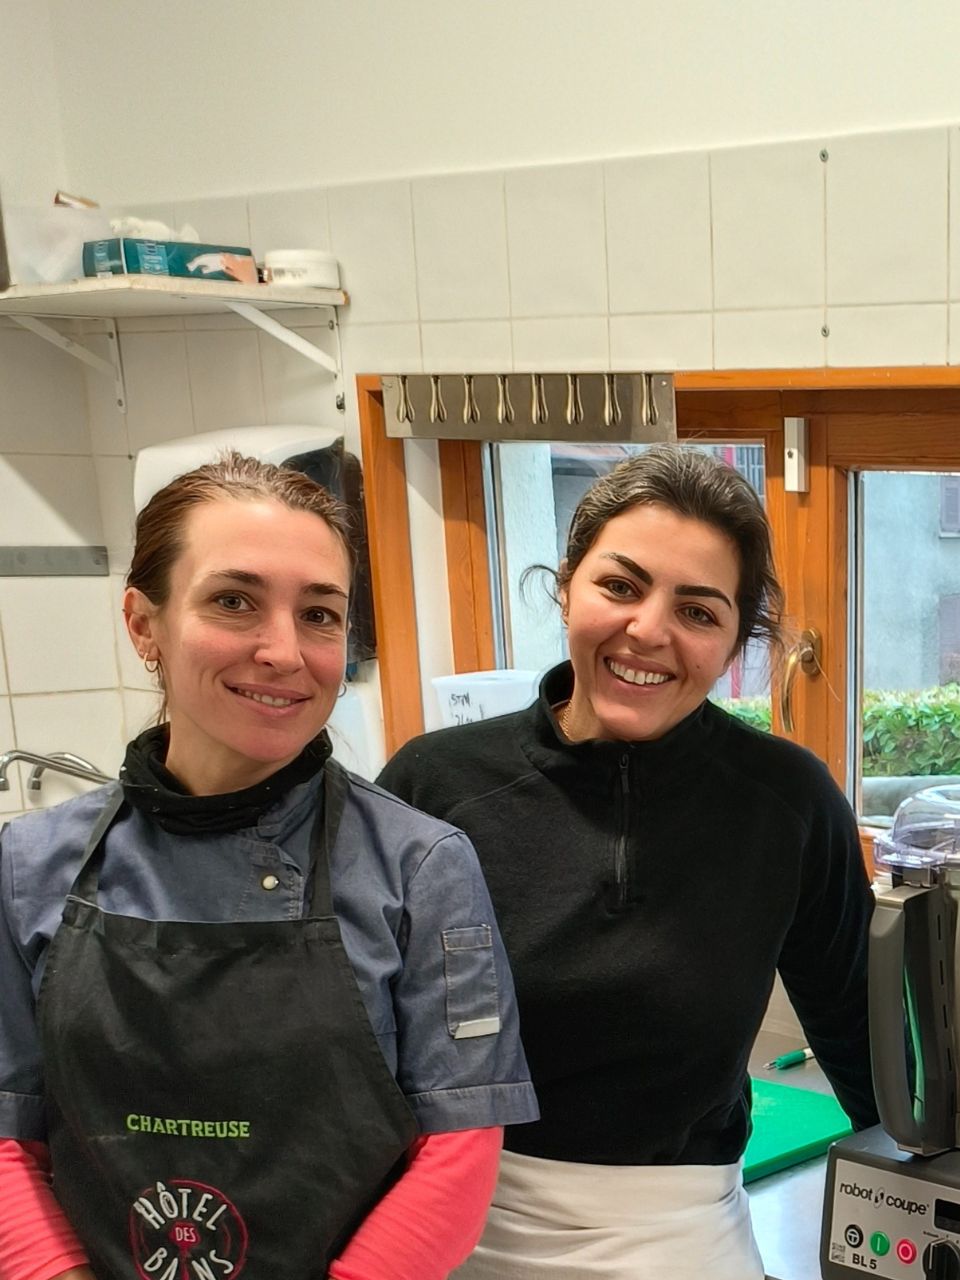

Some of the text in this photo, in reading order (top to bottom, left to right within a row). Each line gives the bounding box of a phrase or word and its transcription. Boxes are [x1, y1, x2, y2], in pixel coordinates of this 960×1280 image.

[126, 1113, 250, 1138] CHARTREUSE
[133, 1181, 228, 1231] HÔTEL
[839, 1182, 928, 1216] robot coupe
[175, 1226, 196, 1243] DES
